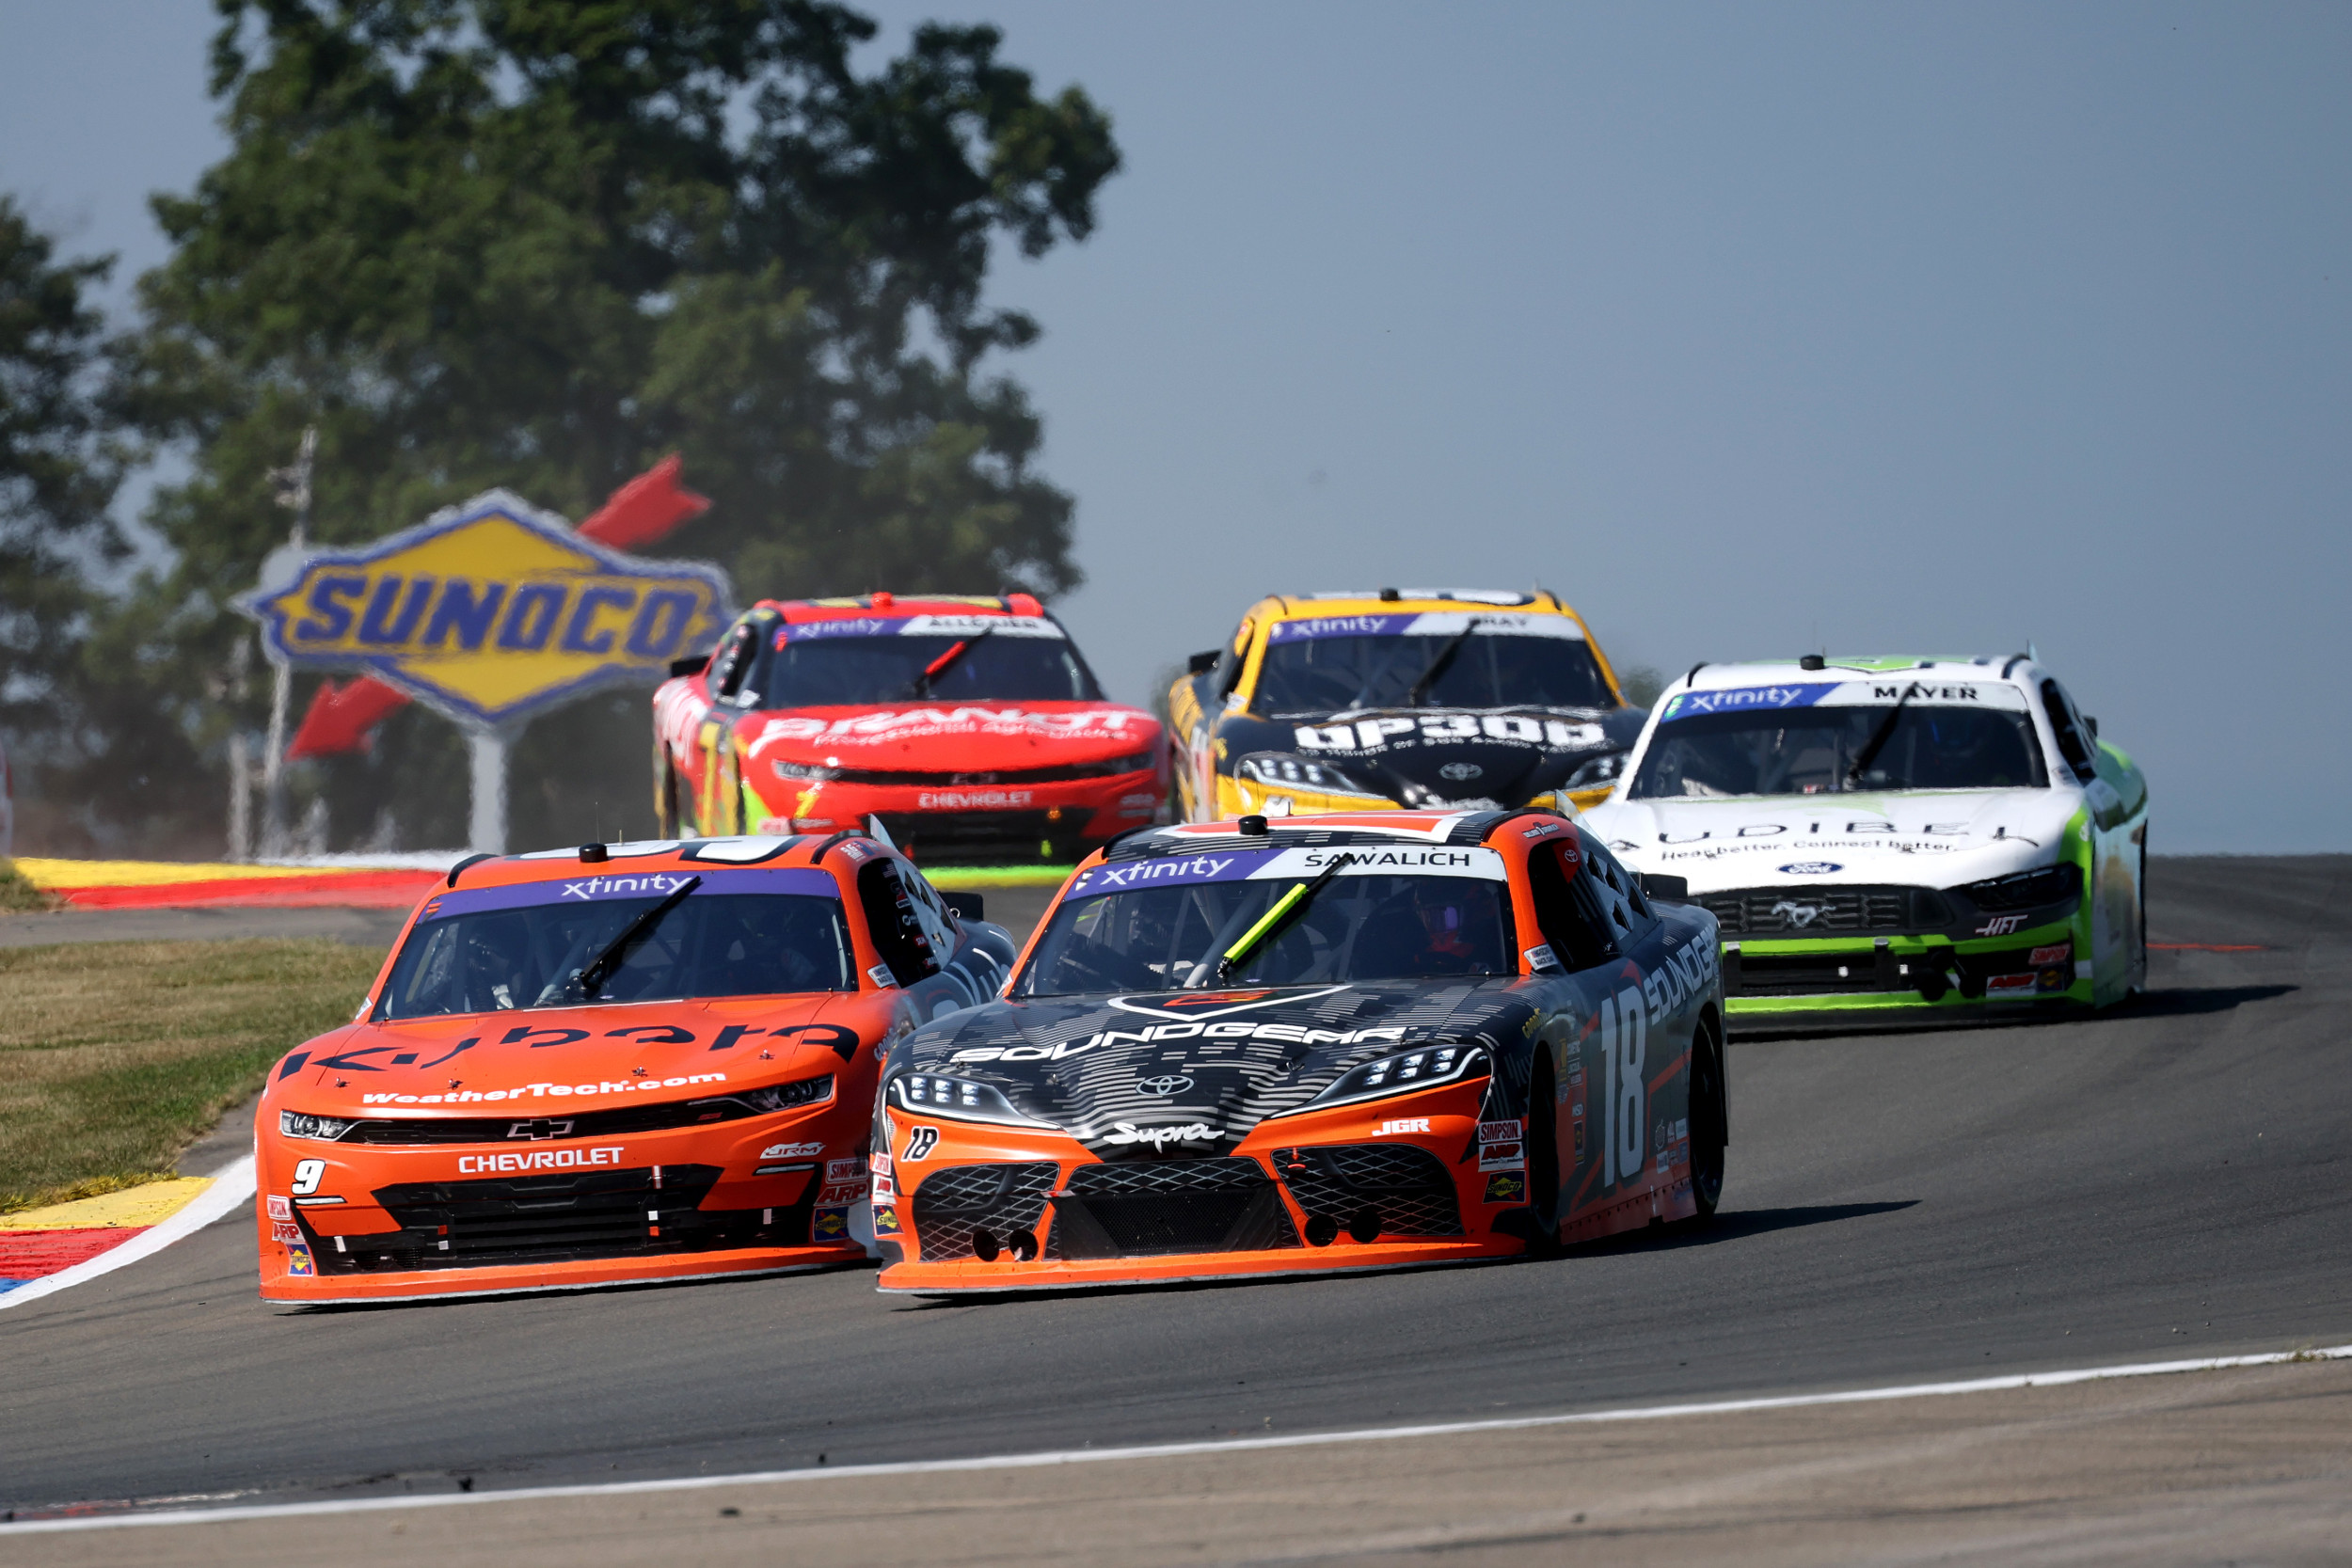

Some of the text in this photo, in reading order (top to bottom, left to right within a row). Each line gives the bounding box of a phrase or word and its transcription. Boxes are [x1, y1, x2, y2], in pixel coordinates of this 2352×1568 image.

[294, 575, 700, 657] SUNOCO
[1292, 616, 1388, 637] xfinity
[1691, 688, 1803, 711] xfinity
[1874, 684, 1979, 701] MAYER
[918, 791, 1033, 809] CHEVROLET
[1100, 856, 1235, 886] xfinity
[1305, 852, 1470, 868] SAWALICH
[562, 873, 692, 900] xfinity
[949, 1022, 1407, 1063] SOUNDGEAR
[1601, 986, 1646, 1188] 18
[1103, 1122, 1225, 1154] Supra
[1372, 1118, 1431, 1136] JGR
[1480, 1121, 1518, 1141] SIMPSON
[766, 1146, 820, 1157] JRM
[900, 1126, 939, 1163] 18
[458, 1147, 625, 1174] CHEVROLET
[291, 1158, 326, 1196] 9
[817, 1183, 867, 1203] ARP
[273, 1224, 300, 1239] ARP
